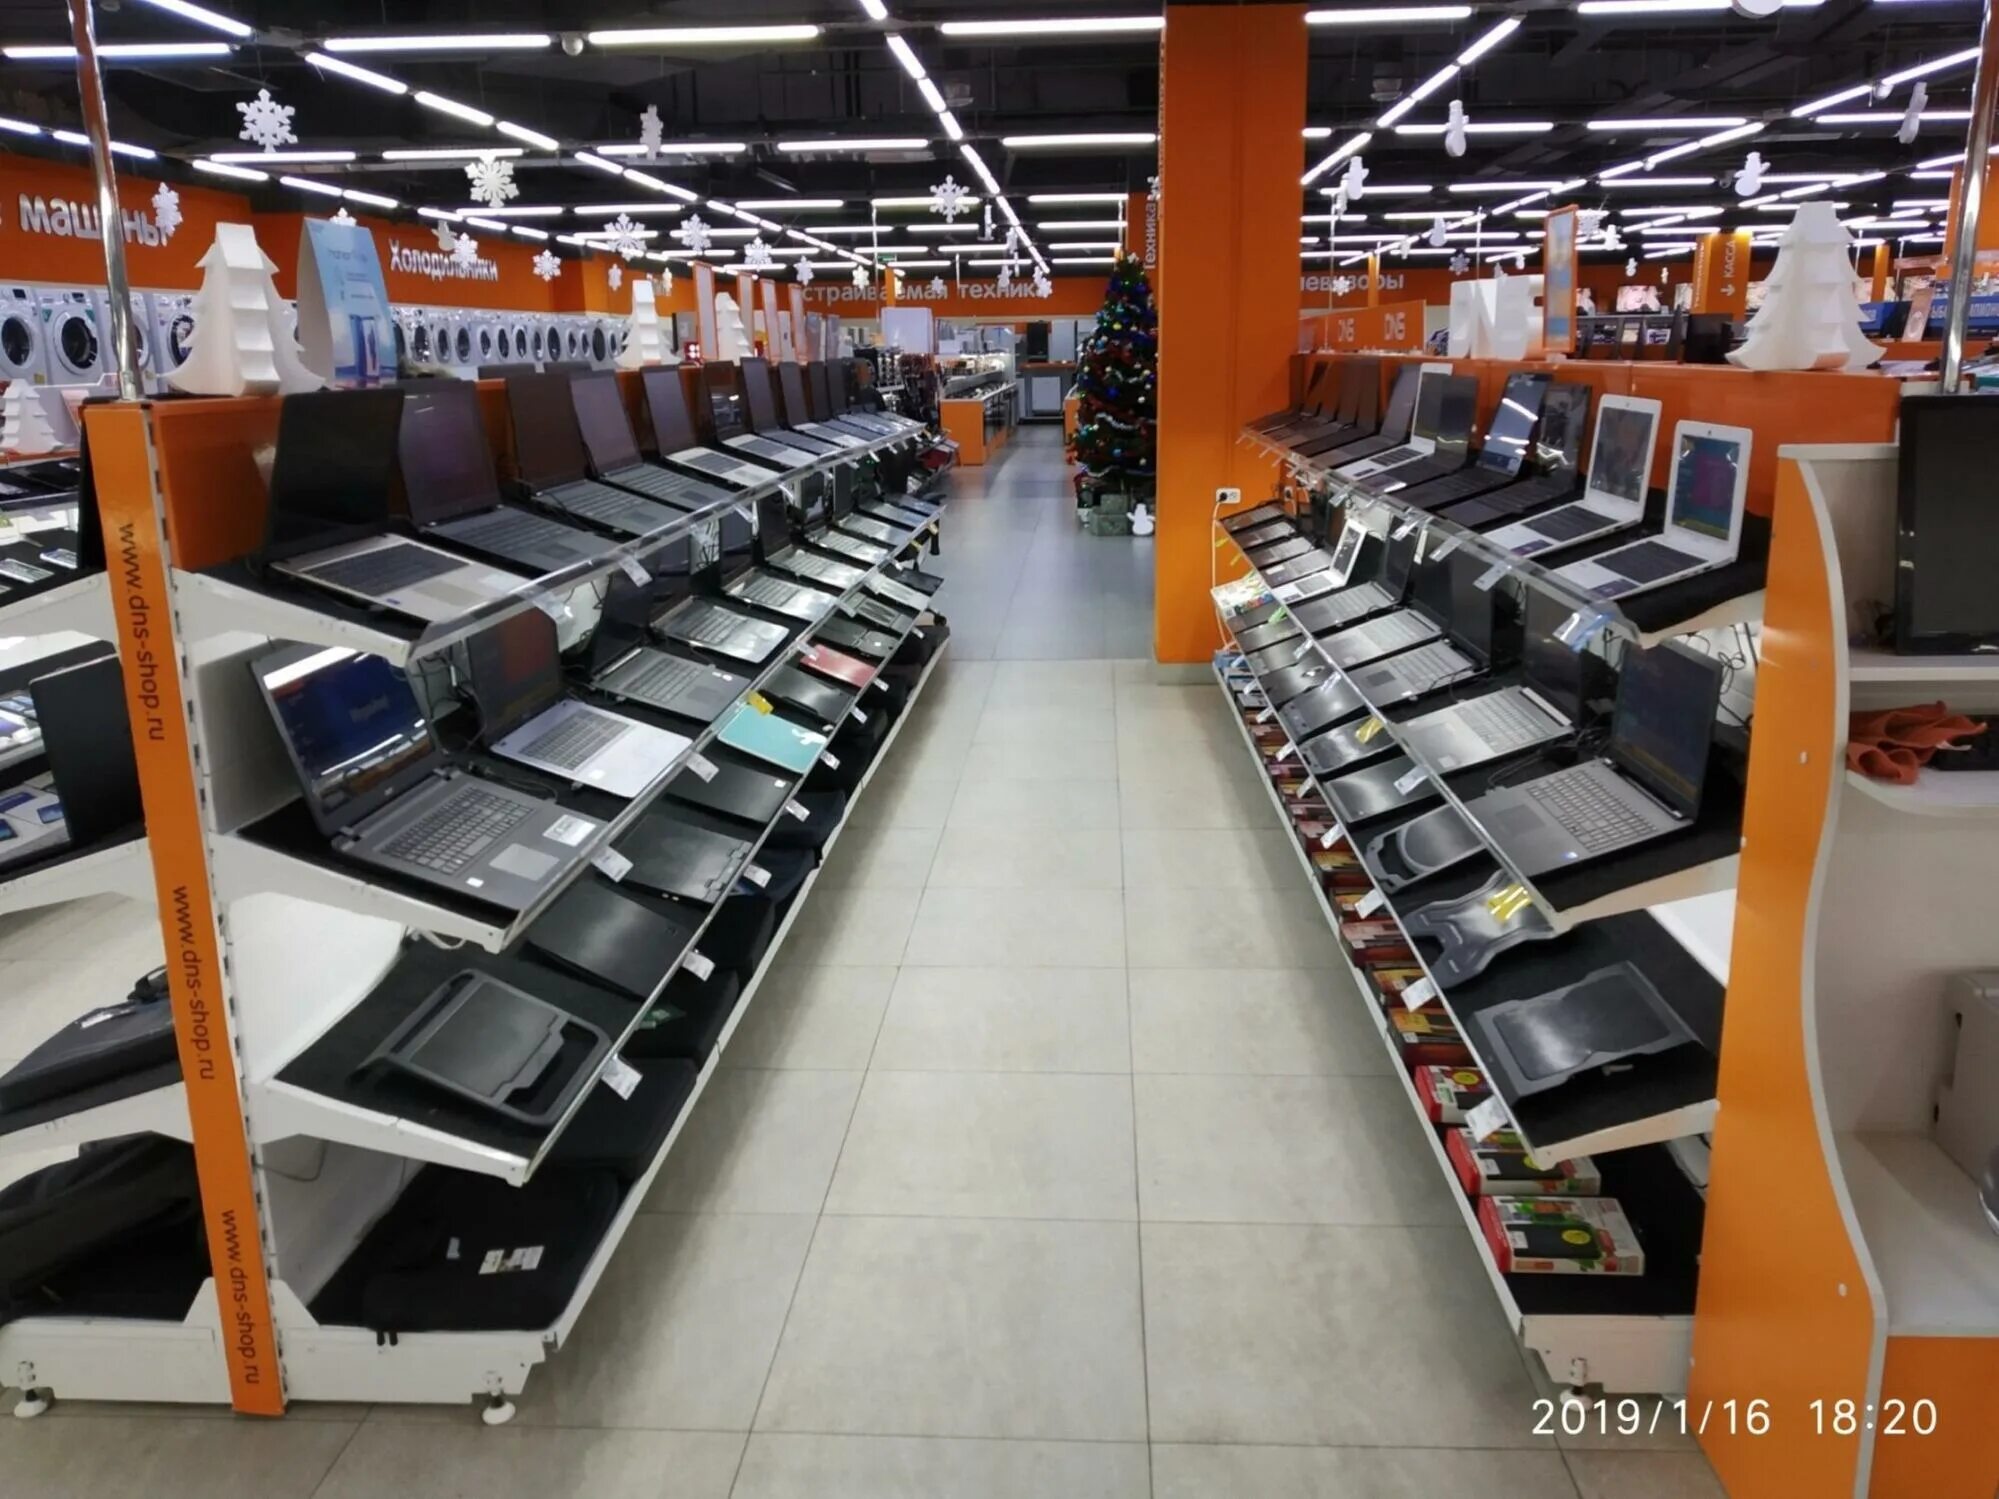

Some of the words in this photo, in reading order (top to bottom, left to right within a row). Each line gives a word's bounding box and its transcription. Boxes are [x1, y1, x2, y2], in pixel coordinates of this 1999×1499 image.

[19, 193, 168, 247] машны
[801, 284, 949, 307] страиваемая
[958, 282, 1047, 299] техник
[1300, 274, 1404, 291] евзоы
[119, 523, 165, 741] www.dns-shop.ru
[173, 886, 215, 1080] www.dns-shop.ru
[222, 1210, 260, 1384] www.dns-shop.ru
